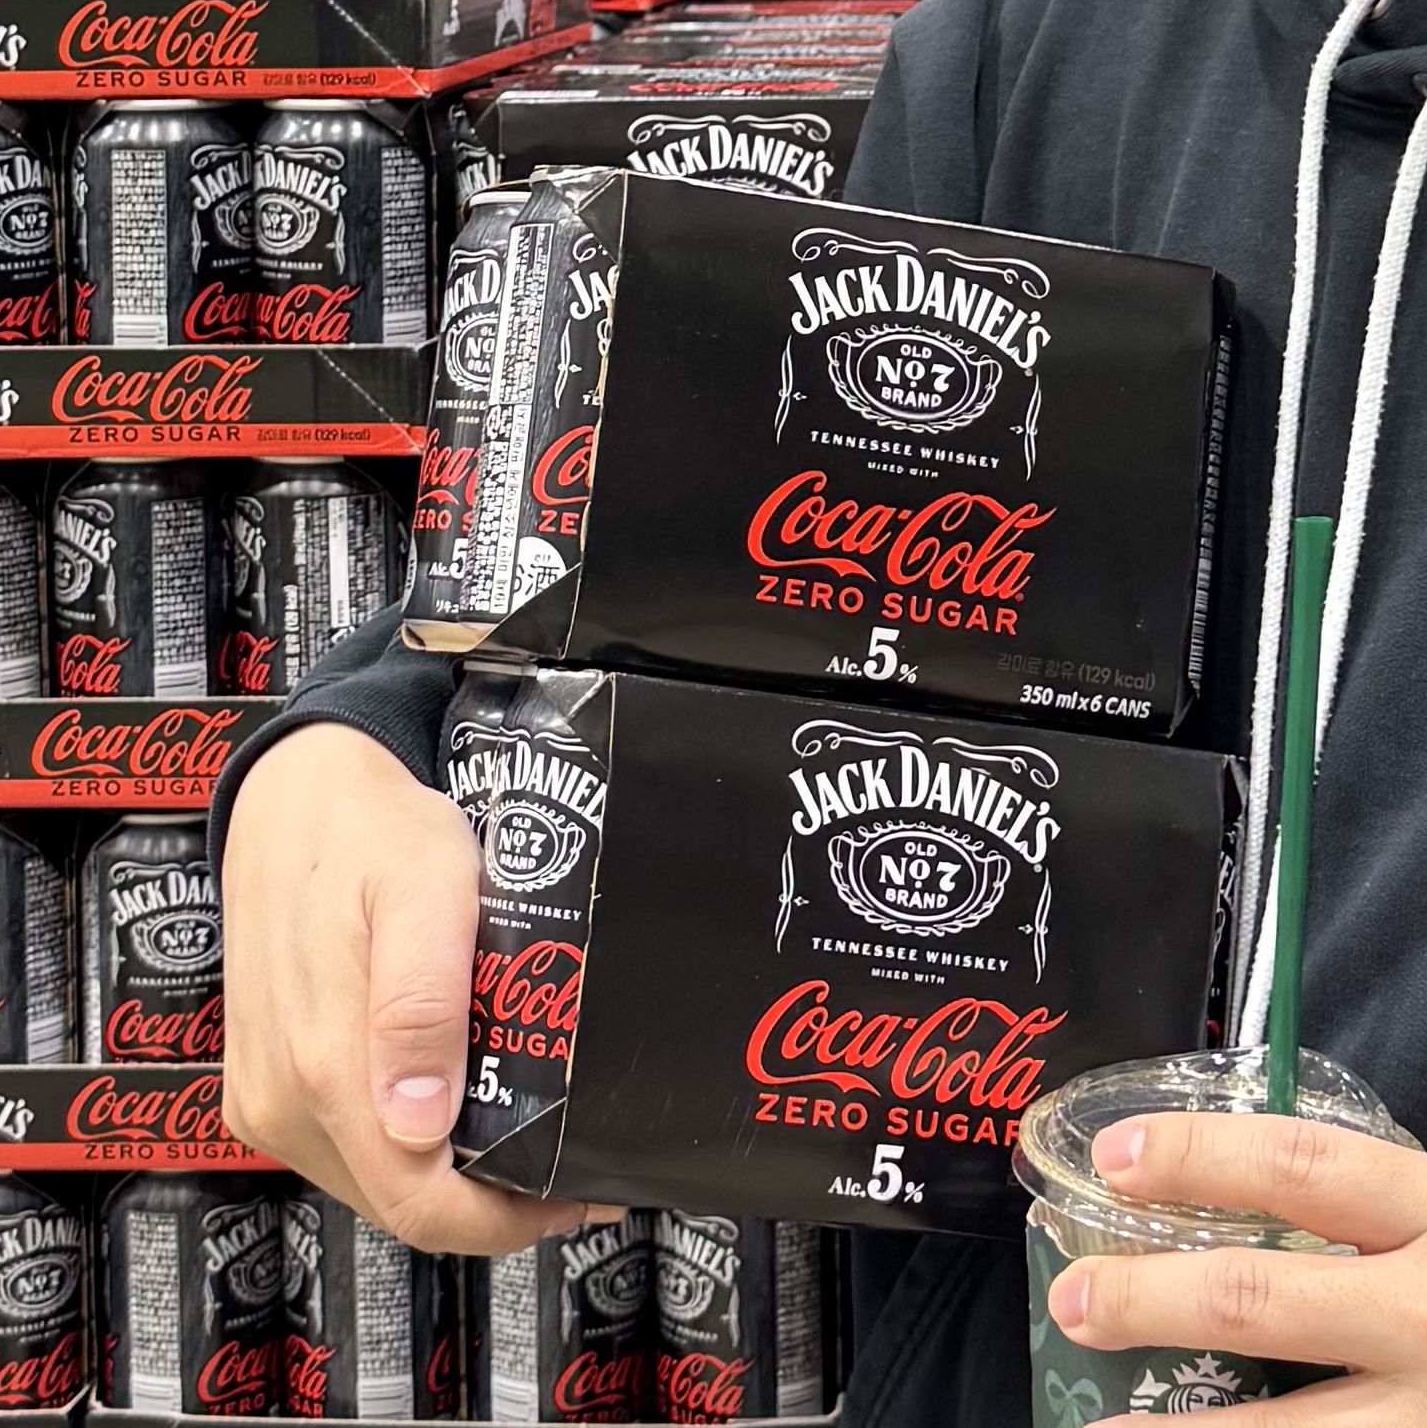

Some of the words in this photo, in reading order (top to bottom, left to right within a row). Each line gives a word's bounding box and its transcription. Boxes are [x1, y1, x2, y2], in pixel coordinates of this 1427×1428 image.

[58, 0, 269, 69] Coca-Cola
[76, 71, 146, 88] ZERO
[158, 70, 247, 87] SUGAR
[788, 265, 892, 335] JACK
[896, 253, 1051, 370] DANIEL'S
[900, 344, 932, 360] OLD
[51, 355, 264, 424] Coca-Cola
[880, 386, 942, 408] BRAND
[69, 427, 139, 443] ZERO
[151, 426, 241, 442] SUGAR
[810, 430, 913, 457] TENNESSEE
[921, 446, 1000, 470] WHISKEY
[747, 470, 1058, 602] Coca-Cola
[755, 574, 865, 614] ZERO
[881, 593, 1018, 636] SUGAR
[1104, 696, 1151, 720] CANS
[788, 767, 895, 837] JACK
[898, 745, 1062, 867] DANIEL'S
[511, 816, 532, 829] OLD
[499, 853, 537, 871] BRAND
[904, 842, 939, 858] OLD
[883, 888, 948, 911] BRAND
[811, 936, 919, 964] TENNESSEE
[927, 951, 1010, 974] WHISKEY
[871, 967, 907, 981] MIXED
[913, 972, 946, 986] WITH
[746, 980, 1069, 1111] Coca-Cola
[754, 1092, 868, 1132] ZERO
